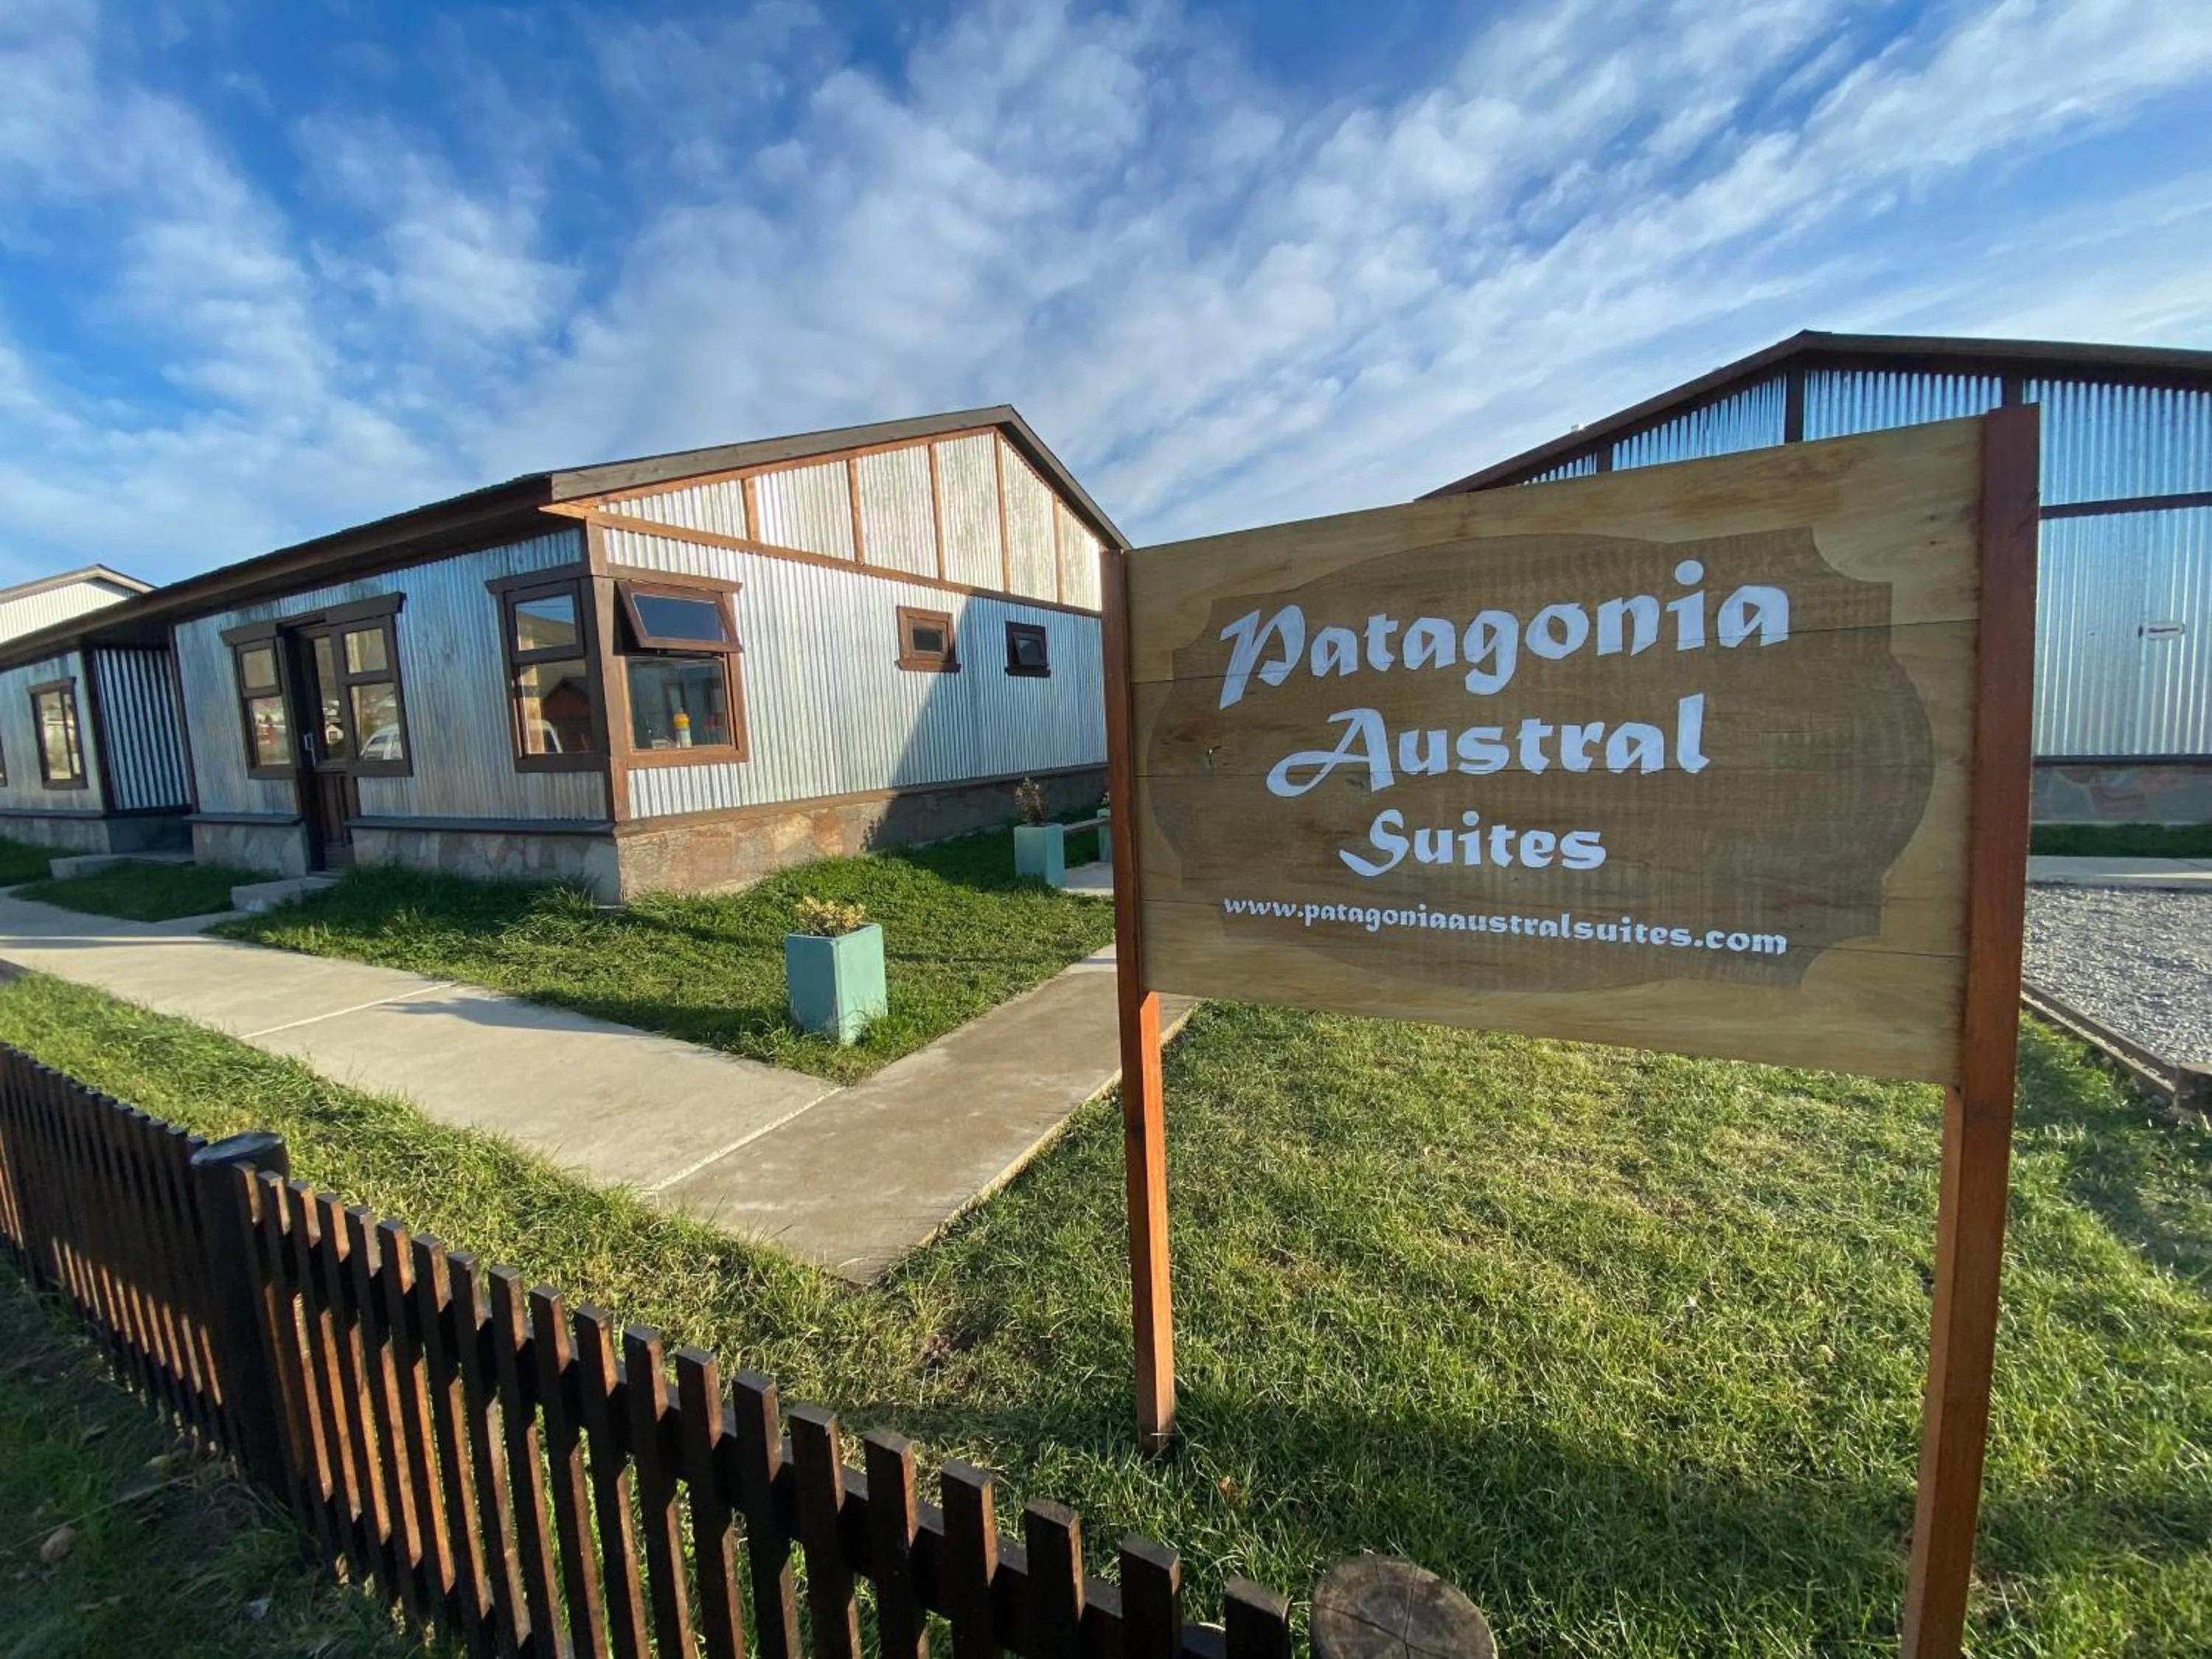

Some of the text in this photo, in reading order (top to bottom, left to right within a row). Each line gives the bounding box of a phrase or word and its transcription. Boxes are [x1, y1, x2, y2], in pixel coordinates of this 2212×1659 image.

[1219, 560, 1790, 709] Patagonia
[1265, 693, 1711, 797] Austral
[1339, 808, 1607, 877] Suites
[1223, 897, 1788, 956] www.patagoniaaustralsuites.com
